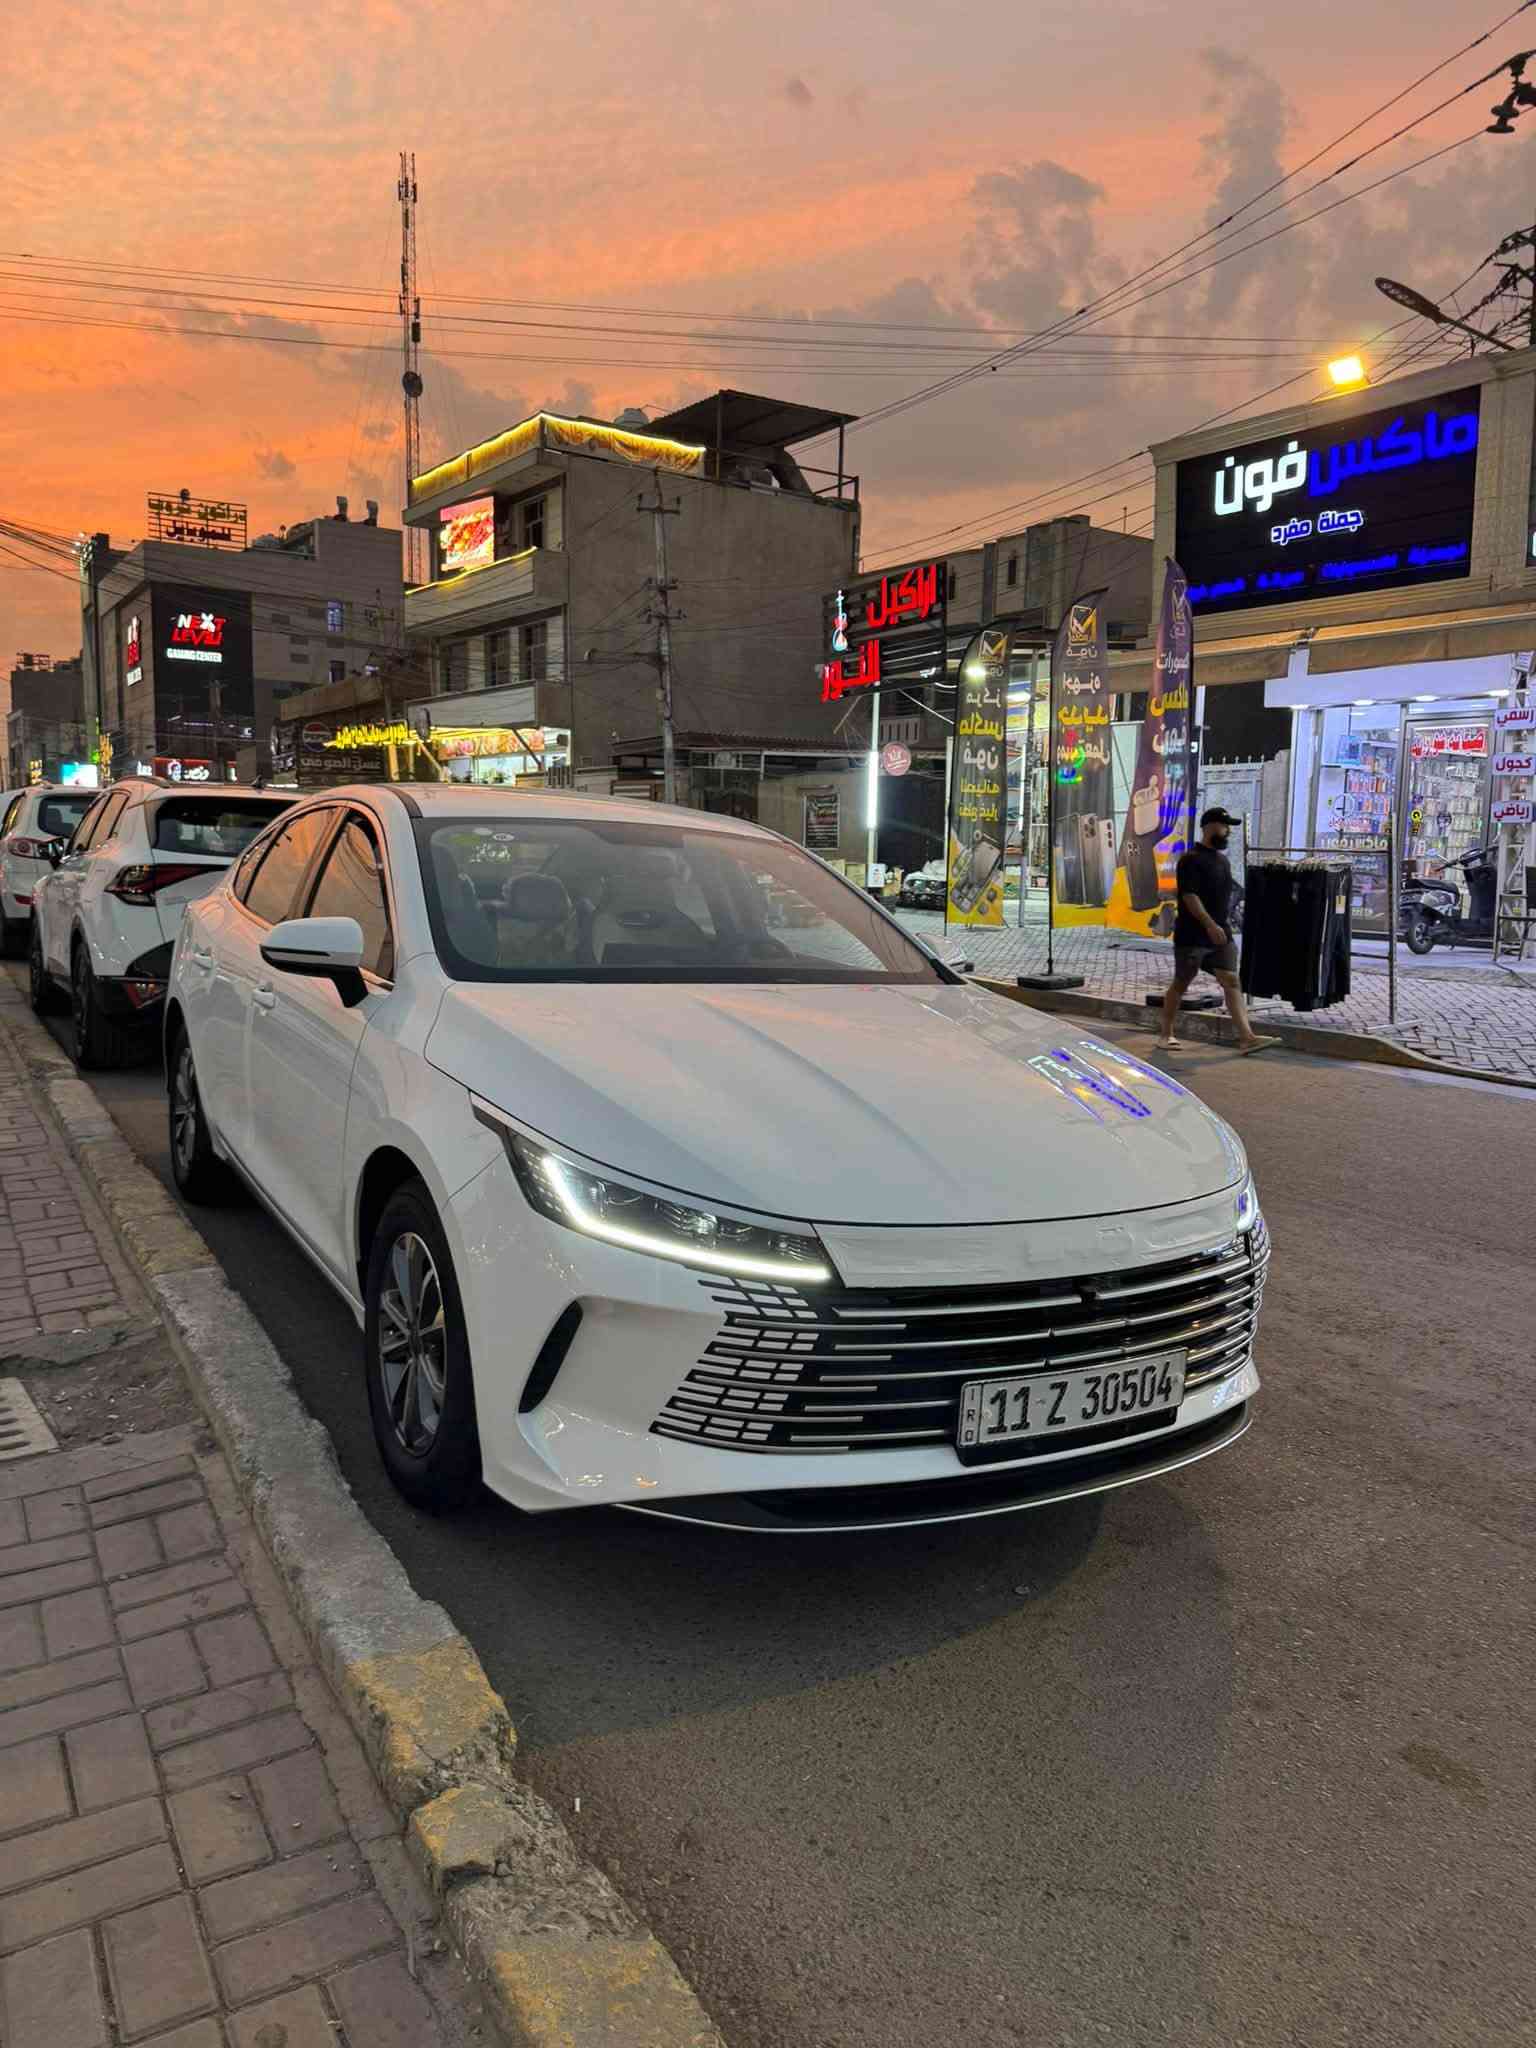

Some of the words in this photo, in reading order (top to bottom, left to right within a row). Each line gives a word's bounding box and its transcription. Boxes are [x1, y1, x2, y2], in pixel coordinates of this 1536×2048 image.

[1308, 411, 1479, 498] ماكس
[1213, 440, 1308, 516] فون
[1271, 517, 1312, 546] مفرد
[1317, 509, 1364, 533] جملة
[866, 563, 938, 628] اراكيل
[177, 611, 226, 633] NEXT
[820, 639, 880, 704] النور
[1496, 709, 1534, 726] رسمي
[1495, 757, 1532, 772] كجول
[1493, 803, 1530, 820] رياضي
[988, 1386, 1030, 1435] 11
[1046, 1380, 1069, 1426] Z
[1081, 1361, 1172, 1420] 30504
